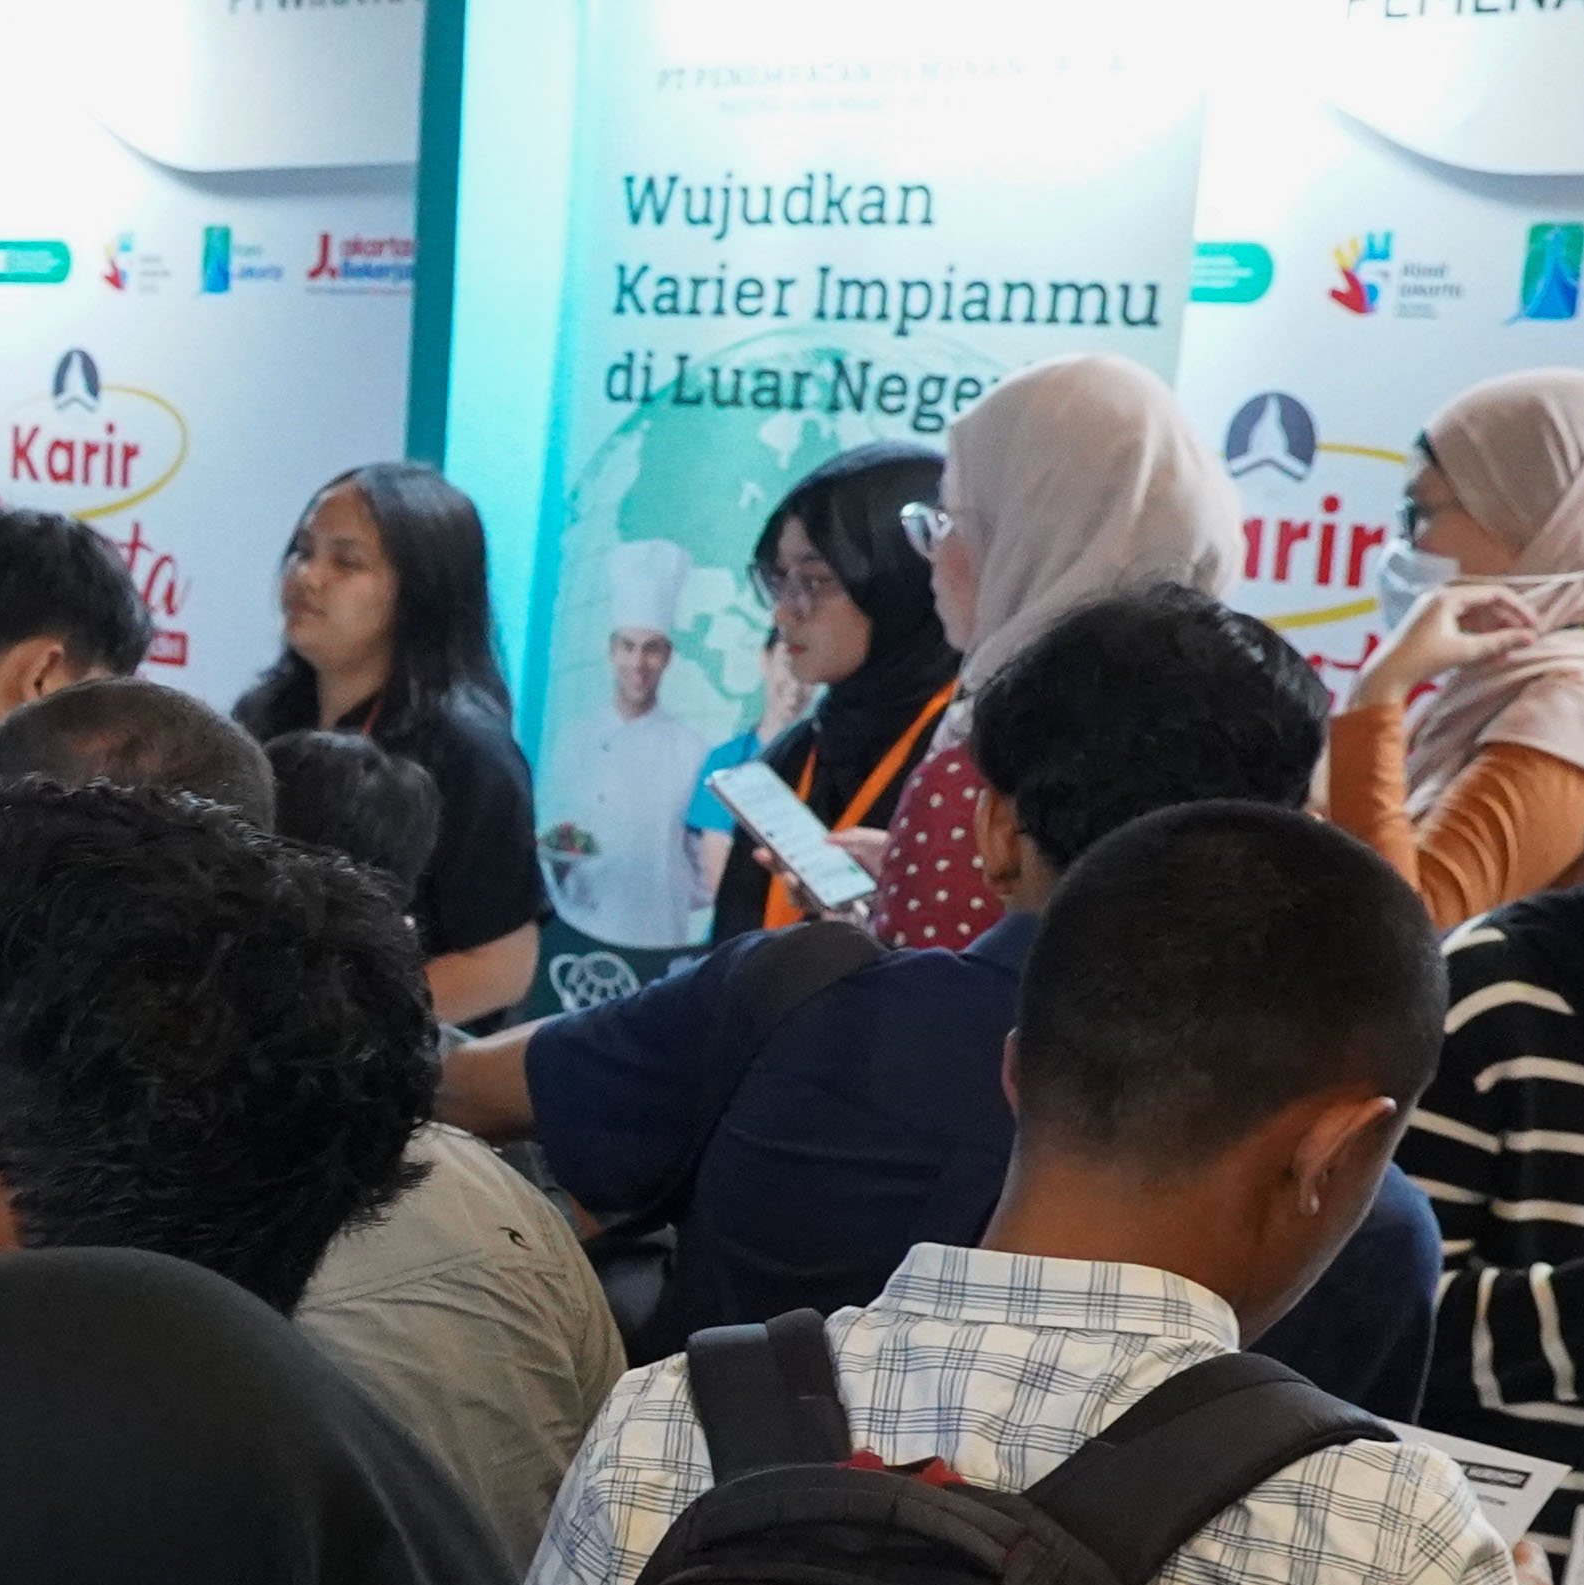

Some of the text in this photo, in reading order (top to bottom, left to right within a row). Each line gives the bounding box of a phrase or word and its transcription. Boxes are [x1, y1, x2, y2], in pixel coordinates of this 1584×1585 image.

[622, 170, 935, 241] Wujudkan
[613, 263, 793, 318] Karier
[815, 268, 1162, 336] Impianmu
[605, 351, 999, 434] di Luar Nege
[11, 421, 140, 488] Karir
[1242, 494, 1387, 589] rir
